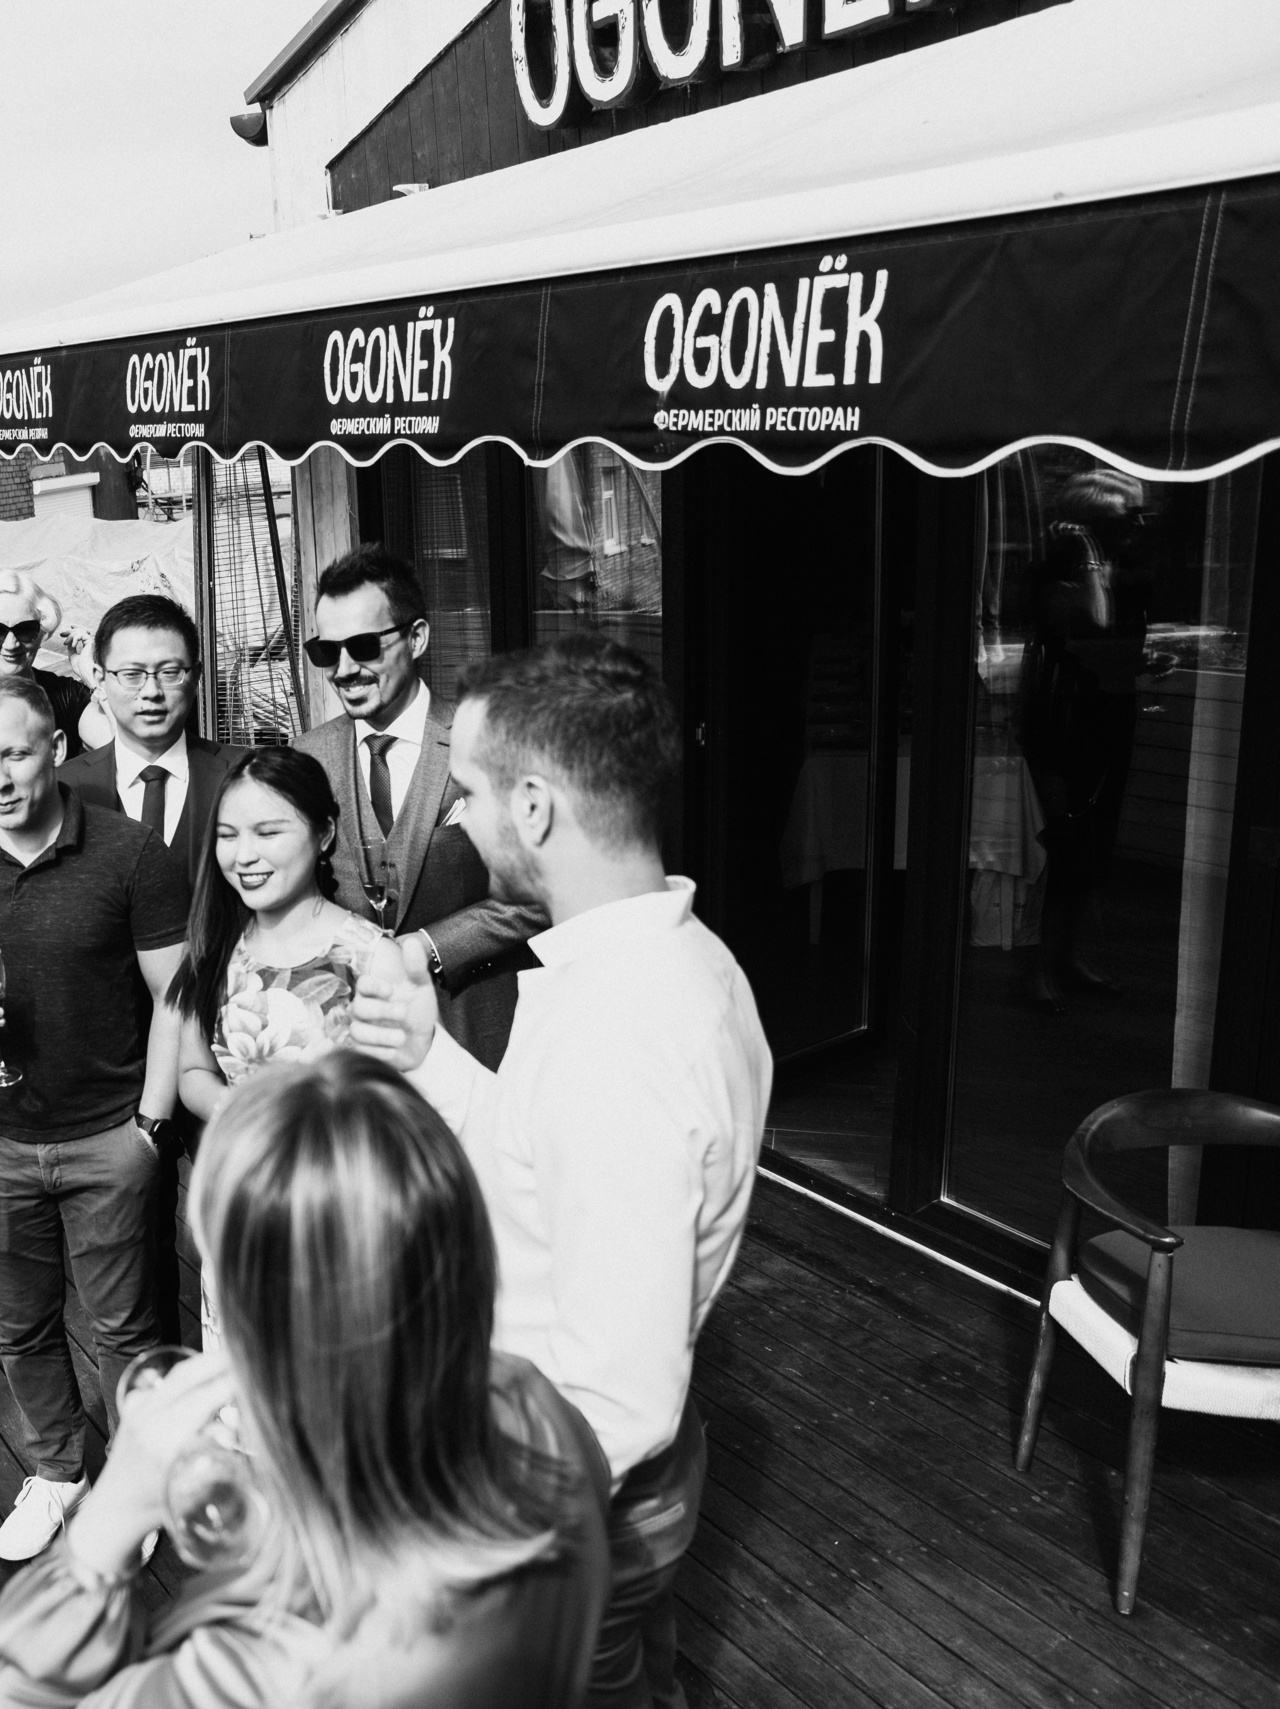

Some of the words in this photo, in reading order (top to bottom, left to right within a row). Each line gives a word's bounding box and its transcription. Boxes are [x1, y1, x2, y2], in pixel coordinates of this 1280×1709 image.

[330, 414, 391, 435] ФЕРМЕРСКИЙ
[394, 416, 440, 434] РЕСТОРАН
[654, 404, 760, 431] ФЕРМЕРСКИЙ
[765, 406, 860, 431] РЕСТОРАН
[167, 423, 205, 437] РЕСТОРАН
